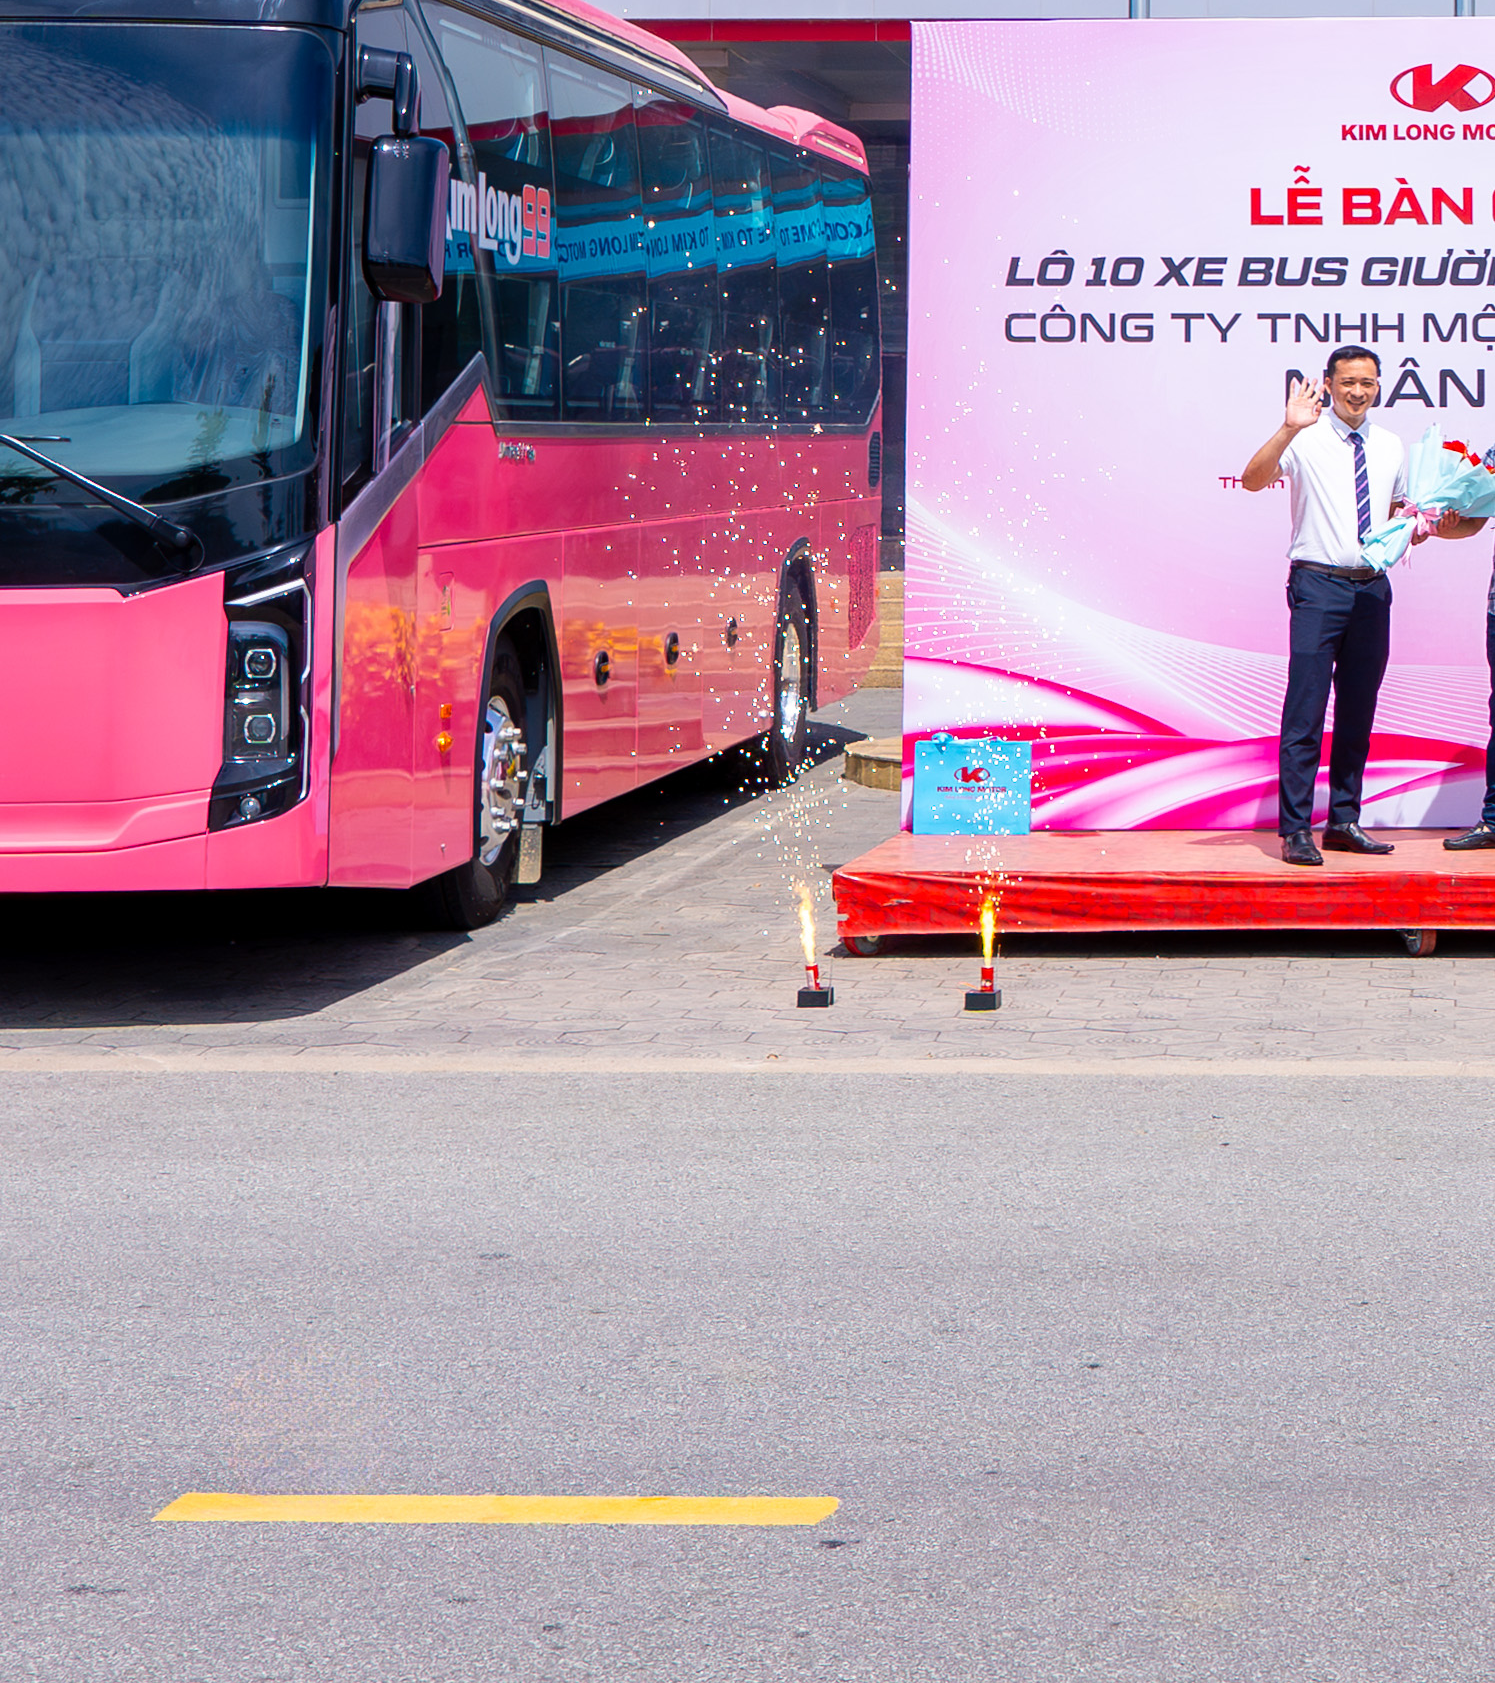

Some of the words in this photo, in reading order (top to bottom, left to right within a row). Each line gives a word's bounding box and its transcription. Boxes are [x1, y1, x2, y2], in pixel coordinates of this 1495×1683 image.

[1341, 124, 1387, 141] KIM
[1393, 123, 1456, 141] LONG
[1250, 165, 1323, 226] LỄ
[1342, 177, 1474, 226] BÀN
[1005, 249, 1075, 287] LÔ
[1084, 256, 1145, 287] 10
[1153, 256, 1228, 287] XE
[1237, 256, 1349, 287] BUS
[1004, 303, 1154, 343] CÔNG
[1170, 312, 1242, 343] TY
[1256, 312, 1405, 343] TNHH
[1285, 357, 1486, 408] NÂN
